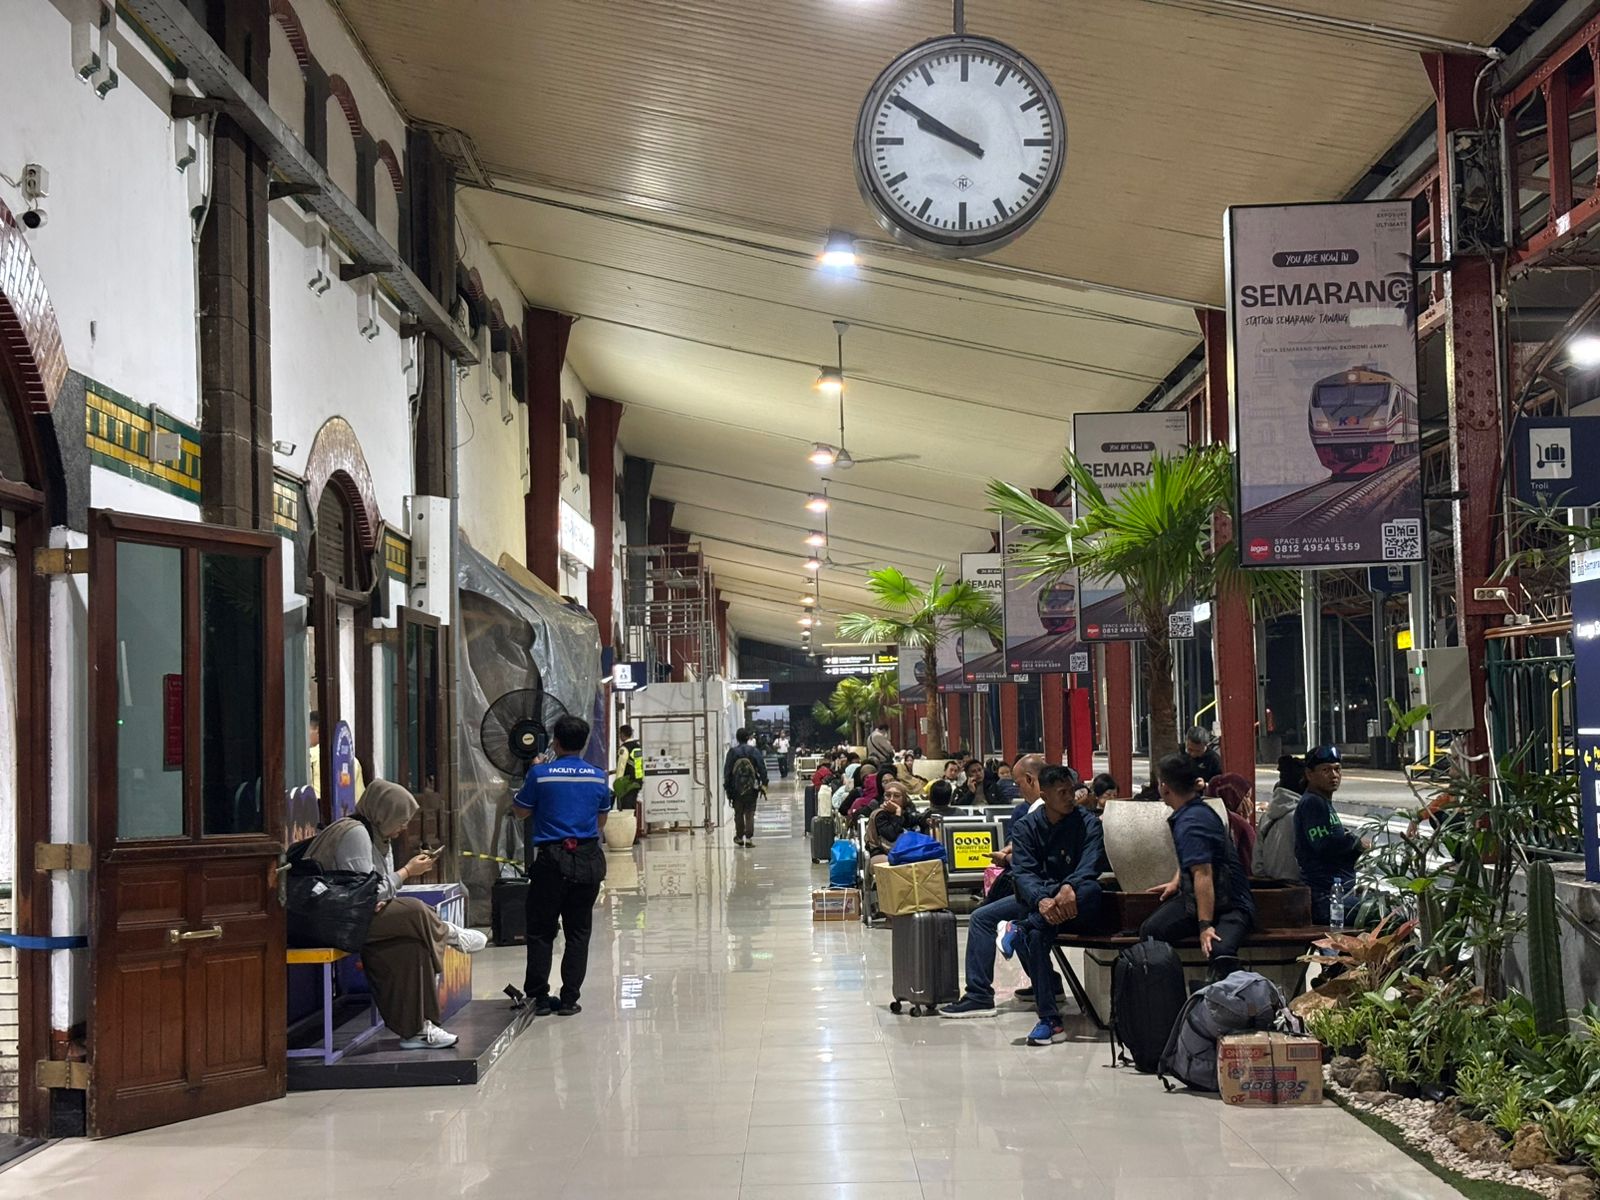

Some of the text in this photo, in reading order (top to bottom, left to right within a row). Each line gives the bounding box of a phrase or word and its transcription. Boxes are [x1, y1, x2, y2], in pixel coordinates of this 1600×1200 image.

[1285, 251, 1349, 265] YOU ARE NOW IN
[1240, 280, 1408, 308] SEMARANG
[1245, 312, 1349, 327] STATION SEMARANG TAWANG
[1530, 481, 1549, 490] Troli
[1274, 544, 1300, 553] 0812
[1303, 543, 1331, 552] 4954
[1334, 542, 1361, 551] 5359
[578, 767, 596, 775] CARE
